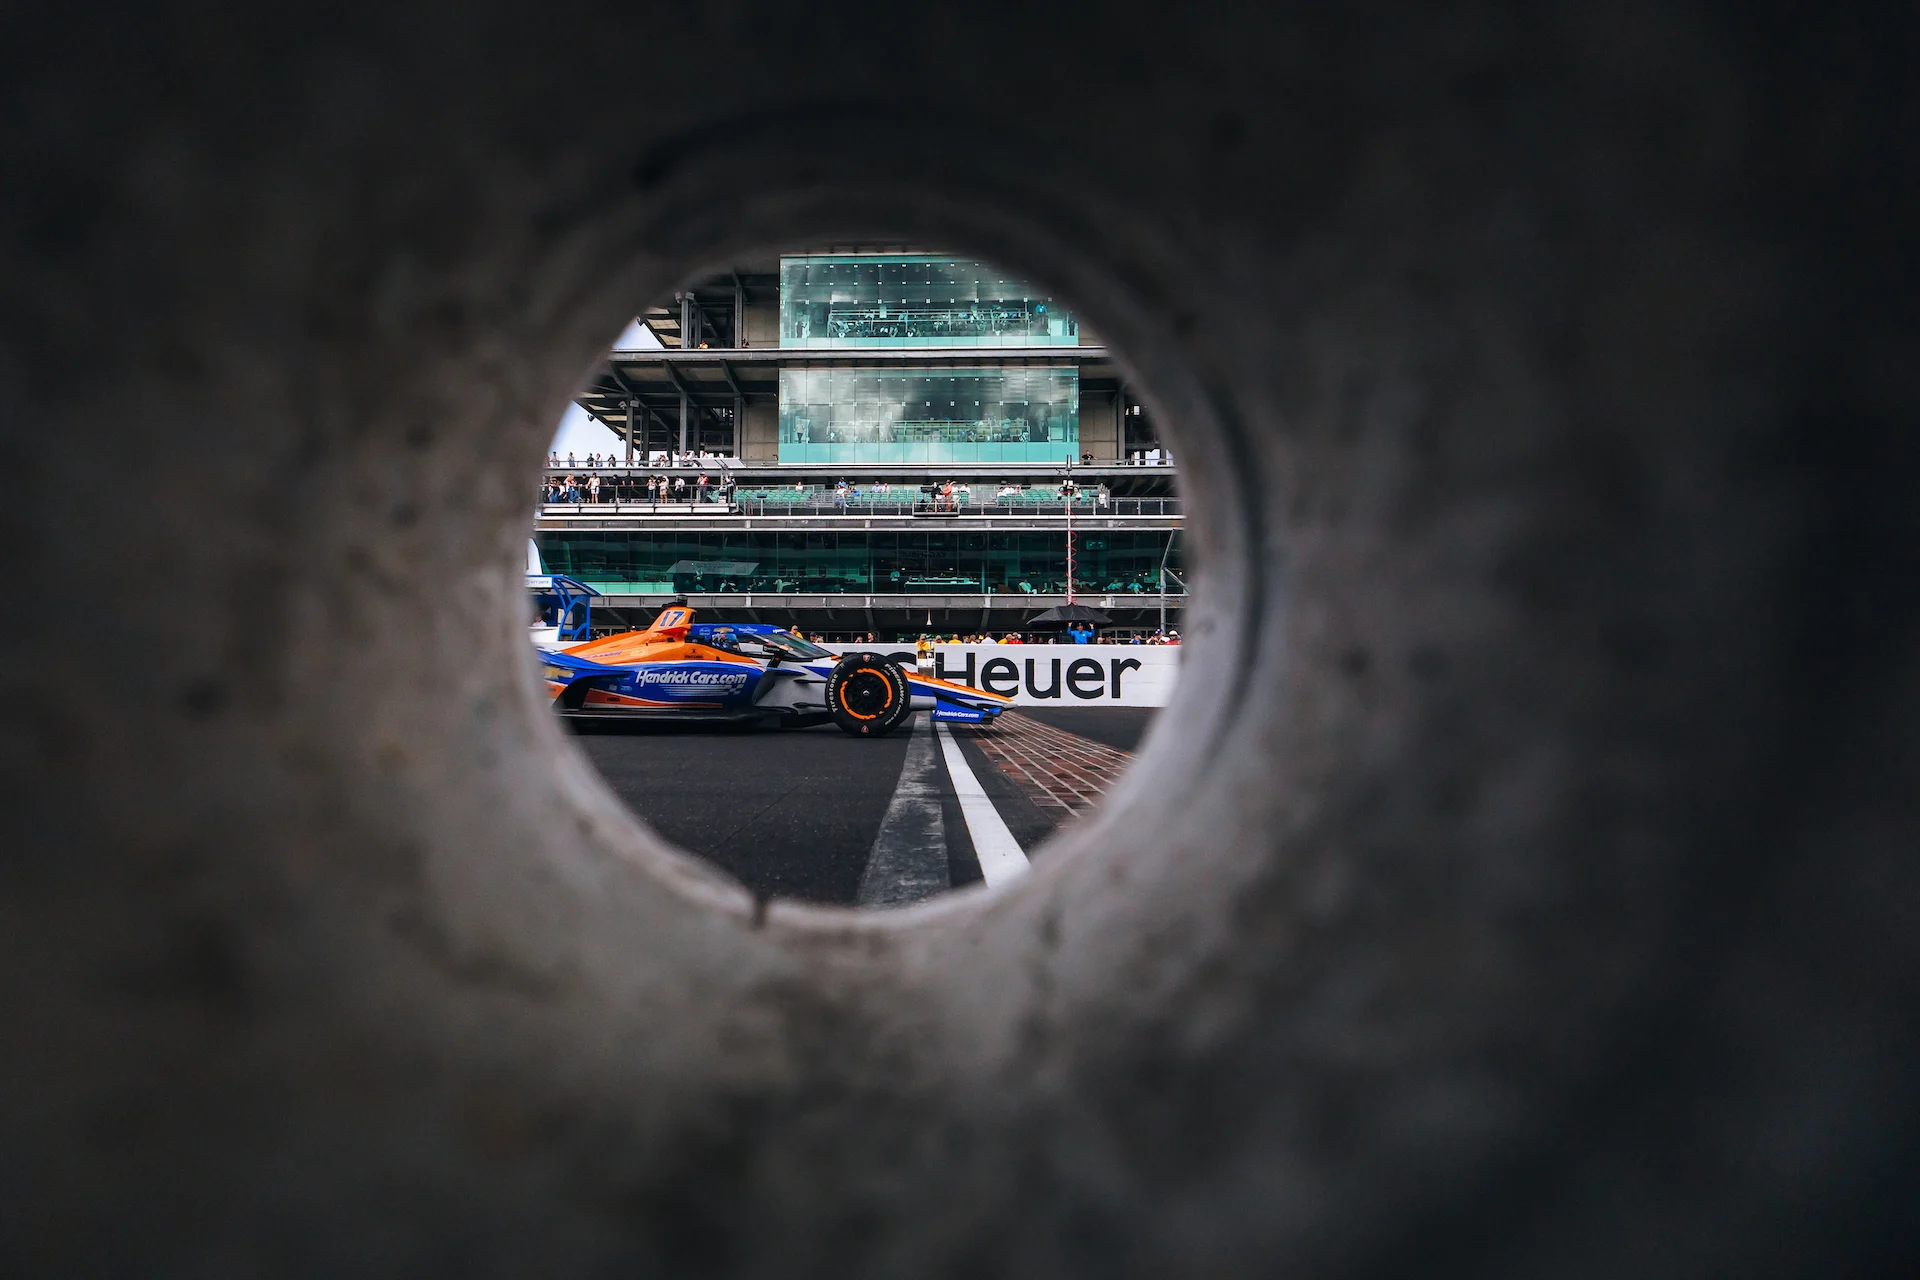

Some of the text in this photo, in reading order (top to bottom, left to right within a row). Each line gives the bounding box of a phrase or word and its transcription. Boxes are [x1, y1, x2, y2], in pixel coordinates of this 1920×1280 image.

[659, 610, 685, 628] 17
[829, 673, 839, 713] Firestone
[935, 652, 1142, 700] Heuer
